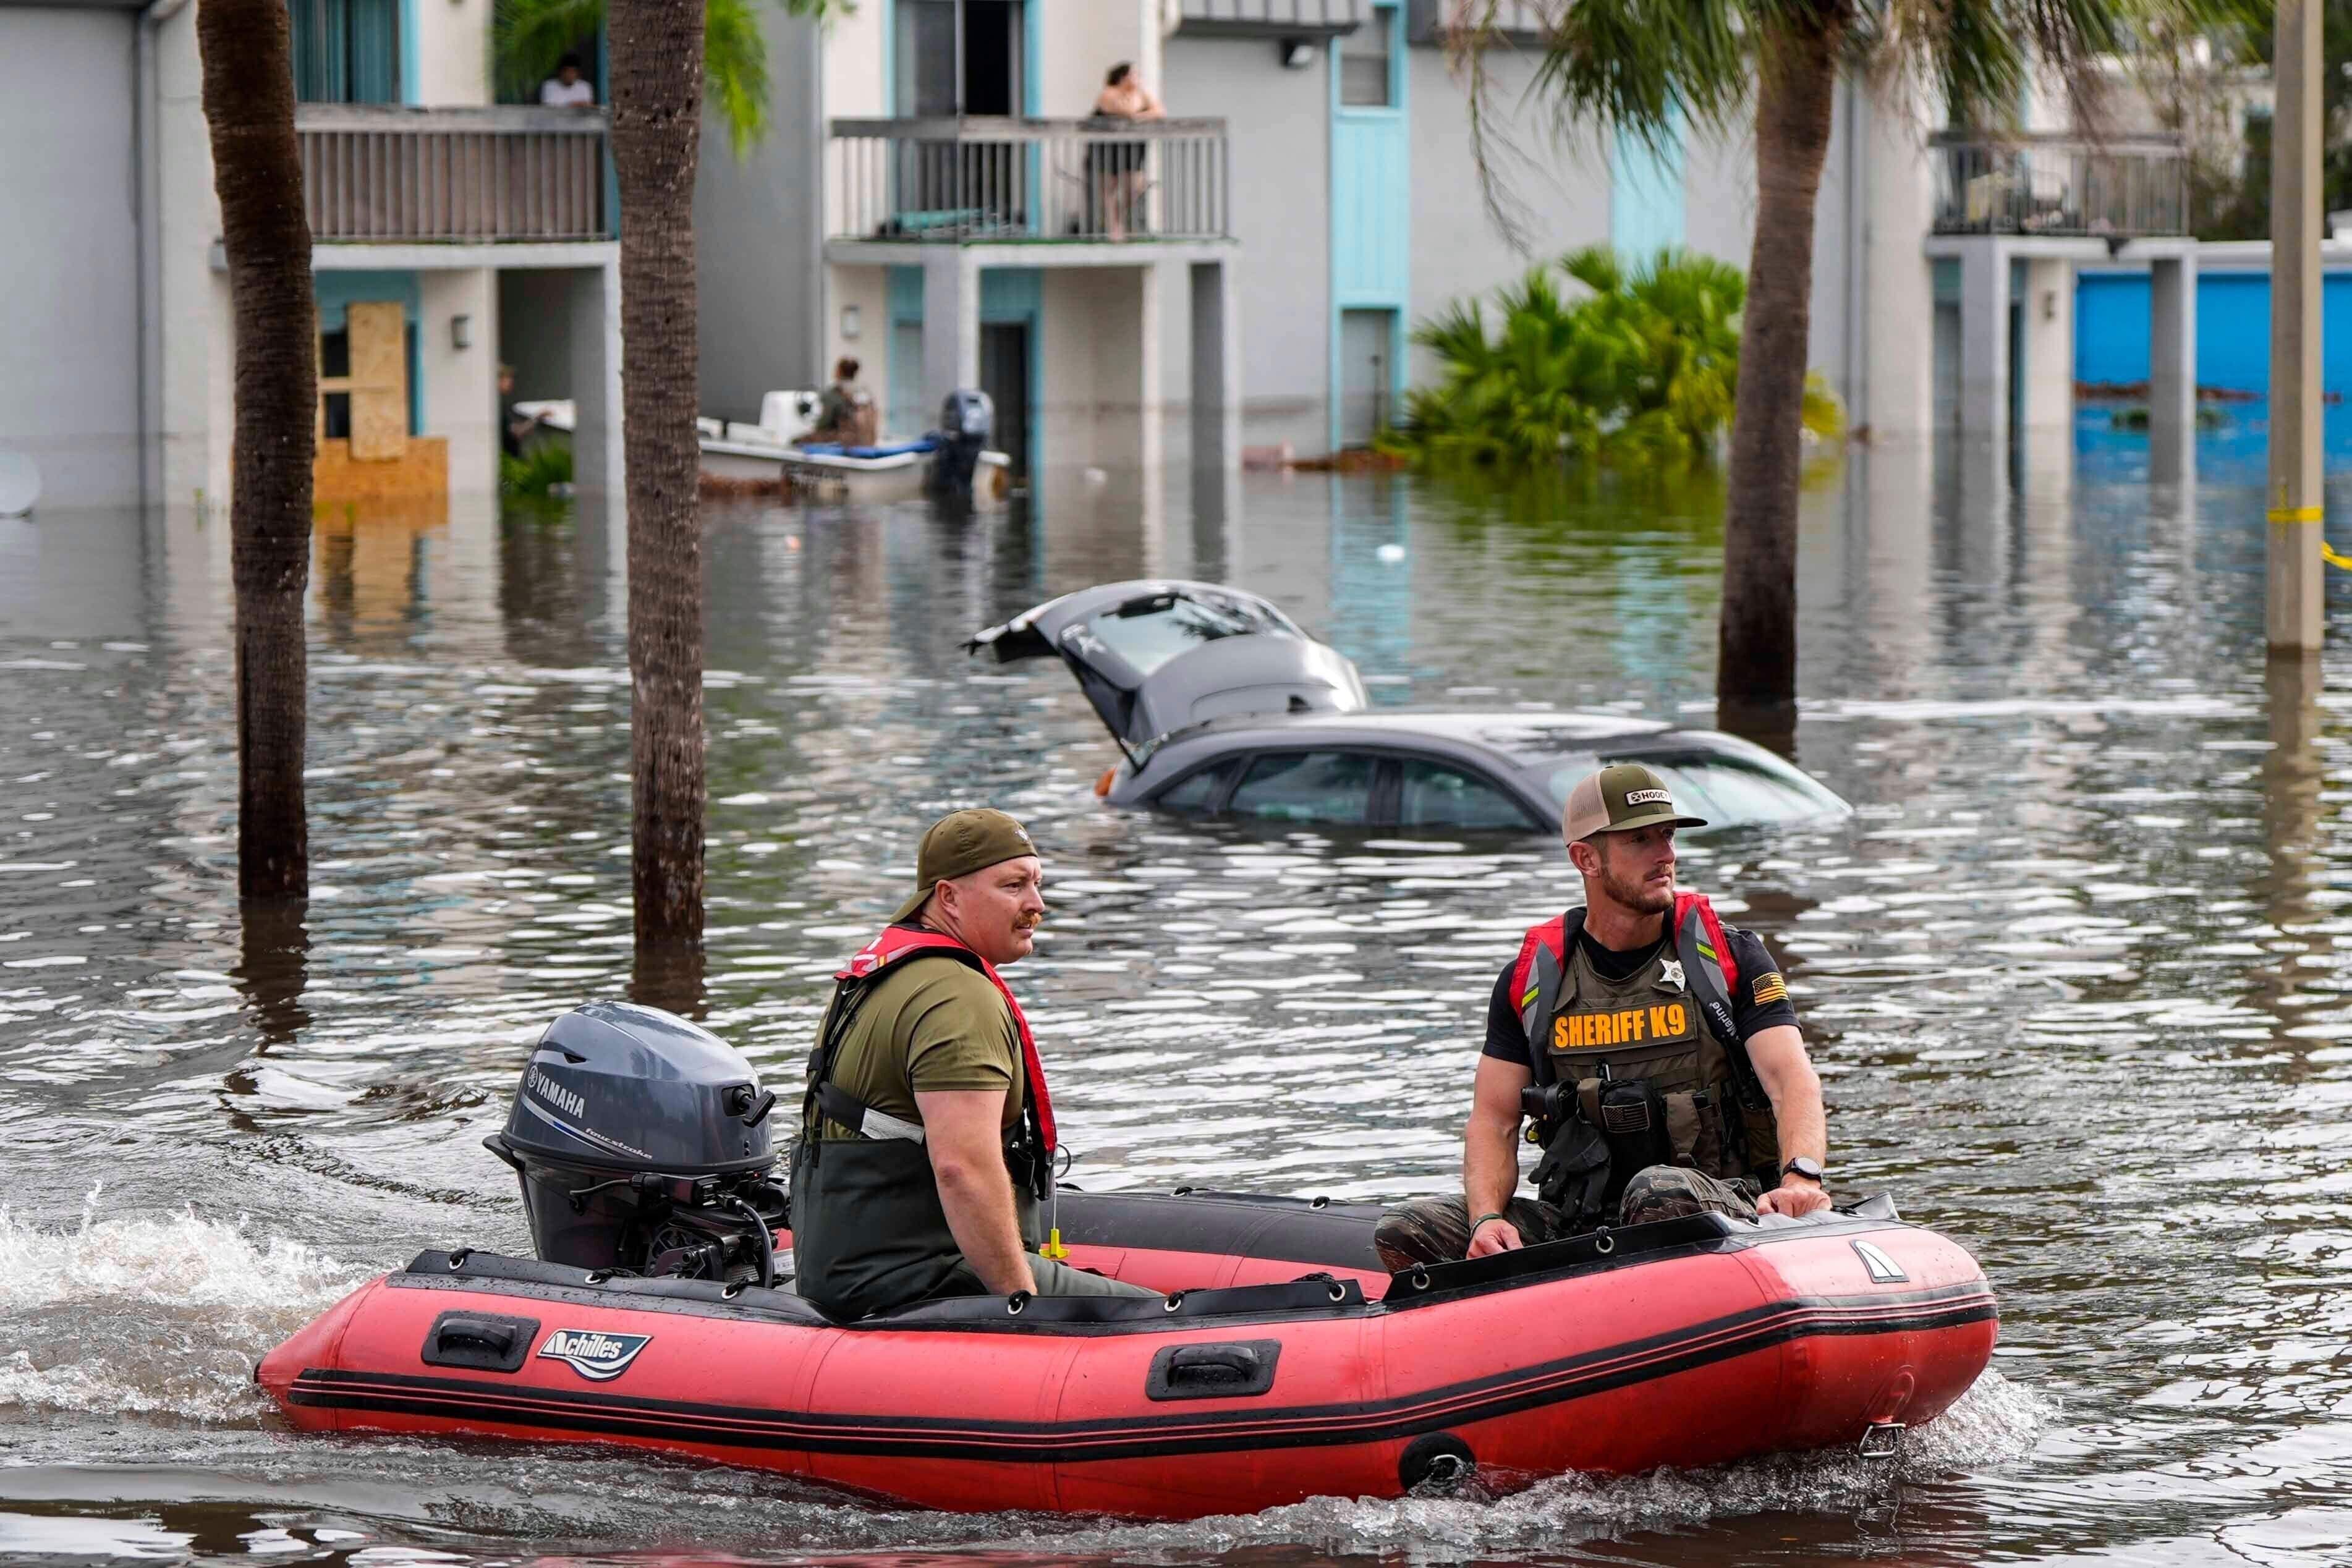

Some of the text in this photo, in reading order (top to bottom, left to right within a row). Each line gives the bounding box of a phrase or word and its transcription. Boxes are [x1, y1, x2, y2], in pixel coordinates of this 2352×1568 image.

[1555, 1004, 1686, 1048] SHERIFF K9
[536, 1073, 585, 1119] YAMAHA
[585, 1128, 653, 1159] fourstroke
[542, 1332, 622, 1358] Achilles
